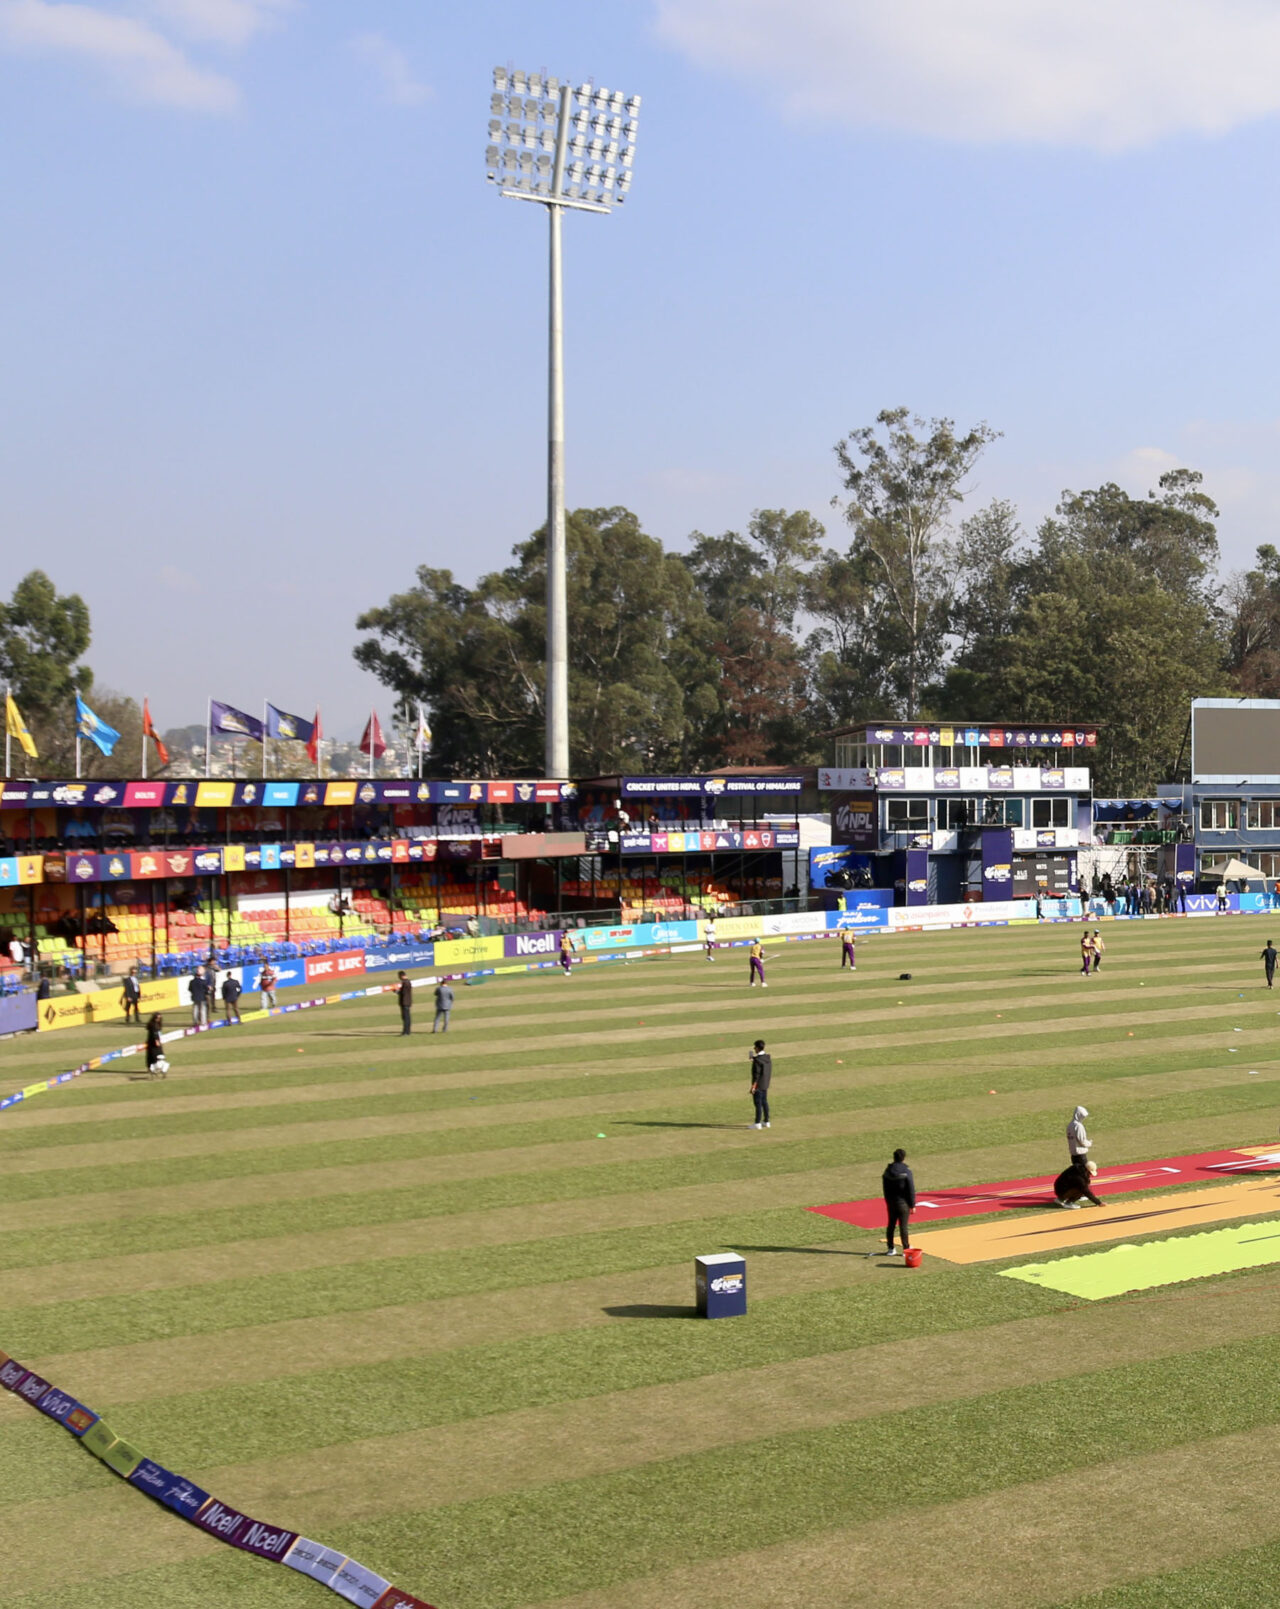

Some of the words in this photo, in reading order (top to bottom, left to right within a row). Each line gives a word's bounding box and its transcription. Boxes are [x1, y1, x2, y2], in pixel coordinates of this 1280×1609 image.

[626, 782, 655, 791] CRICKET
[655, 782, 679, 791] UNITES
[679, 782, 701, 791] NEPAL
[727, 782, 756, 791] FESTIVAL
[755, 782, 766, 791] OF
[765, 782, 801, 791] HIMALAYAS
[848, 812, 873, 829] NPL
[516, 933, 555, 955] Ncell
[0, 1361, 25, 1386] Ncell
[18, 1375, 50, 1400] Ncell
[41, 1394, 72, 1415] vivo
[200, 1503, 244, 1535] Ncell
[241, 1523, 292, 1554] Ncell
